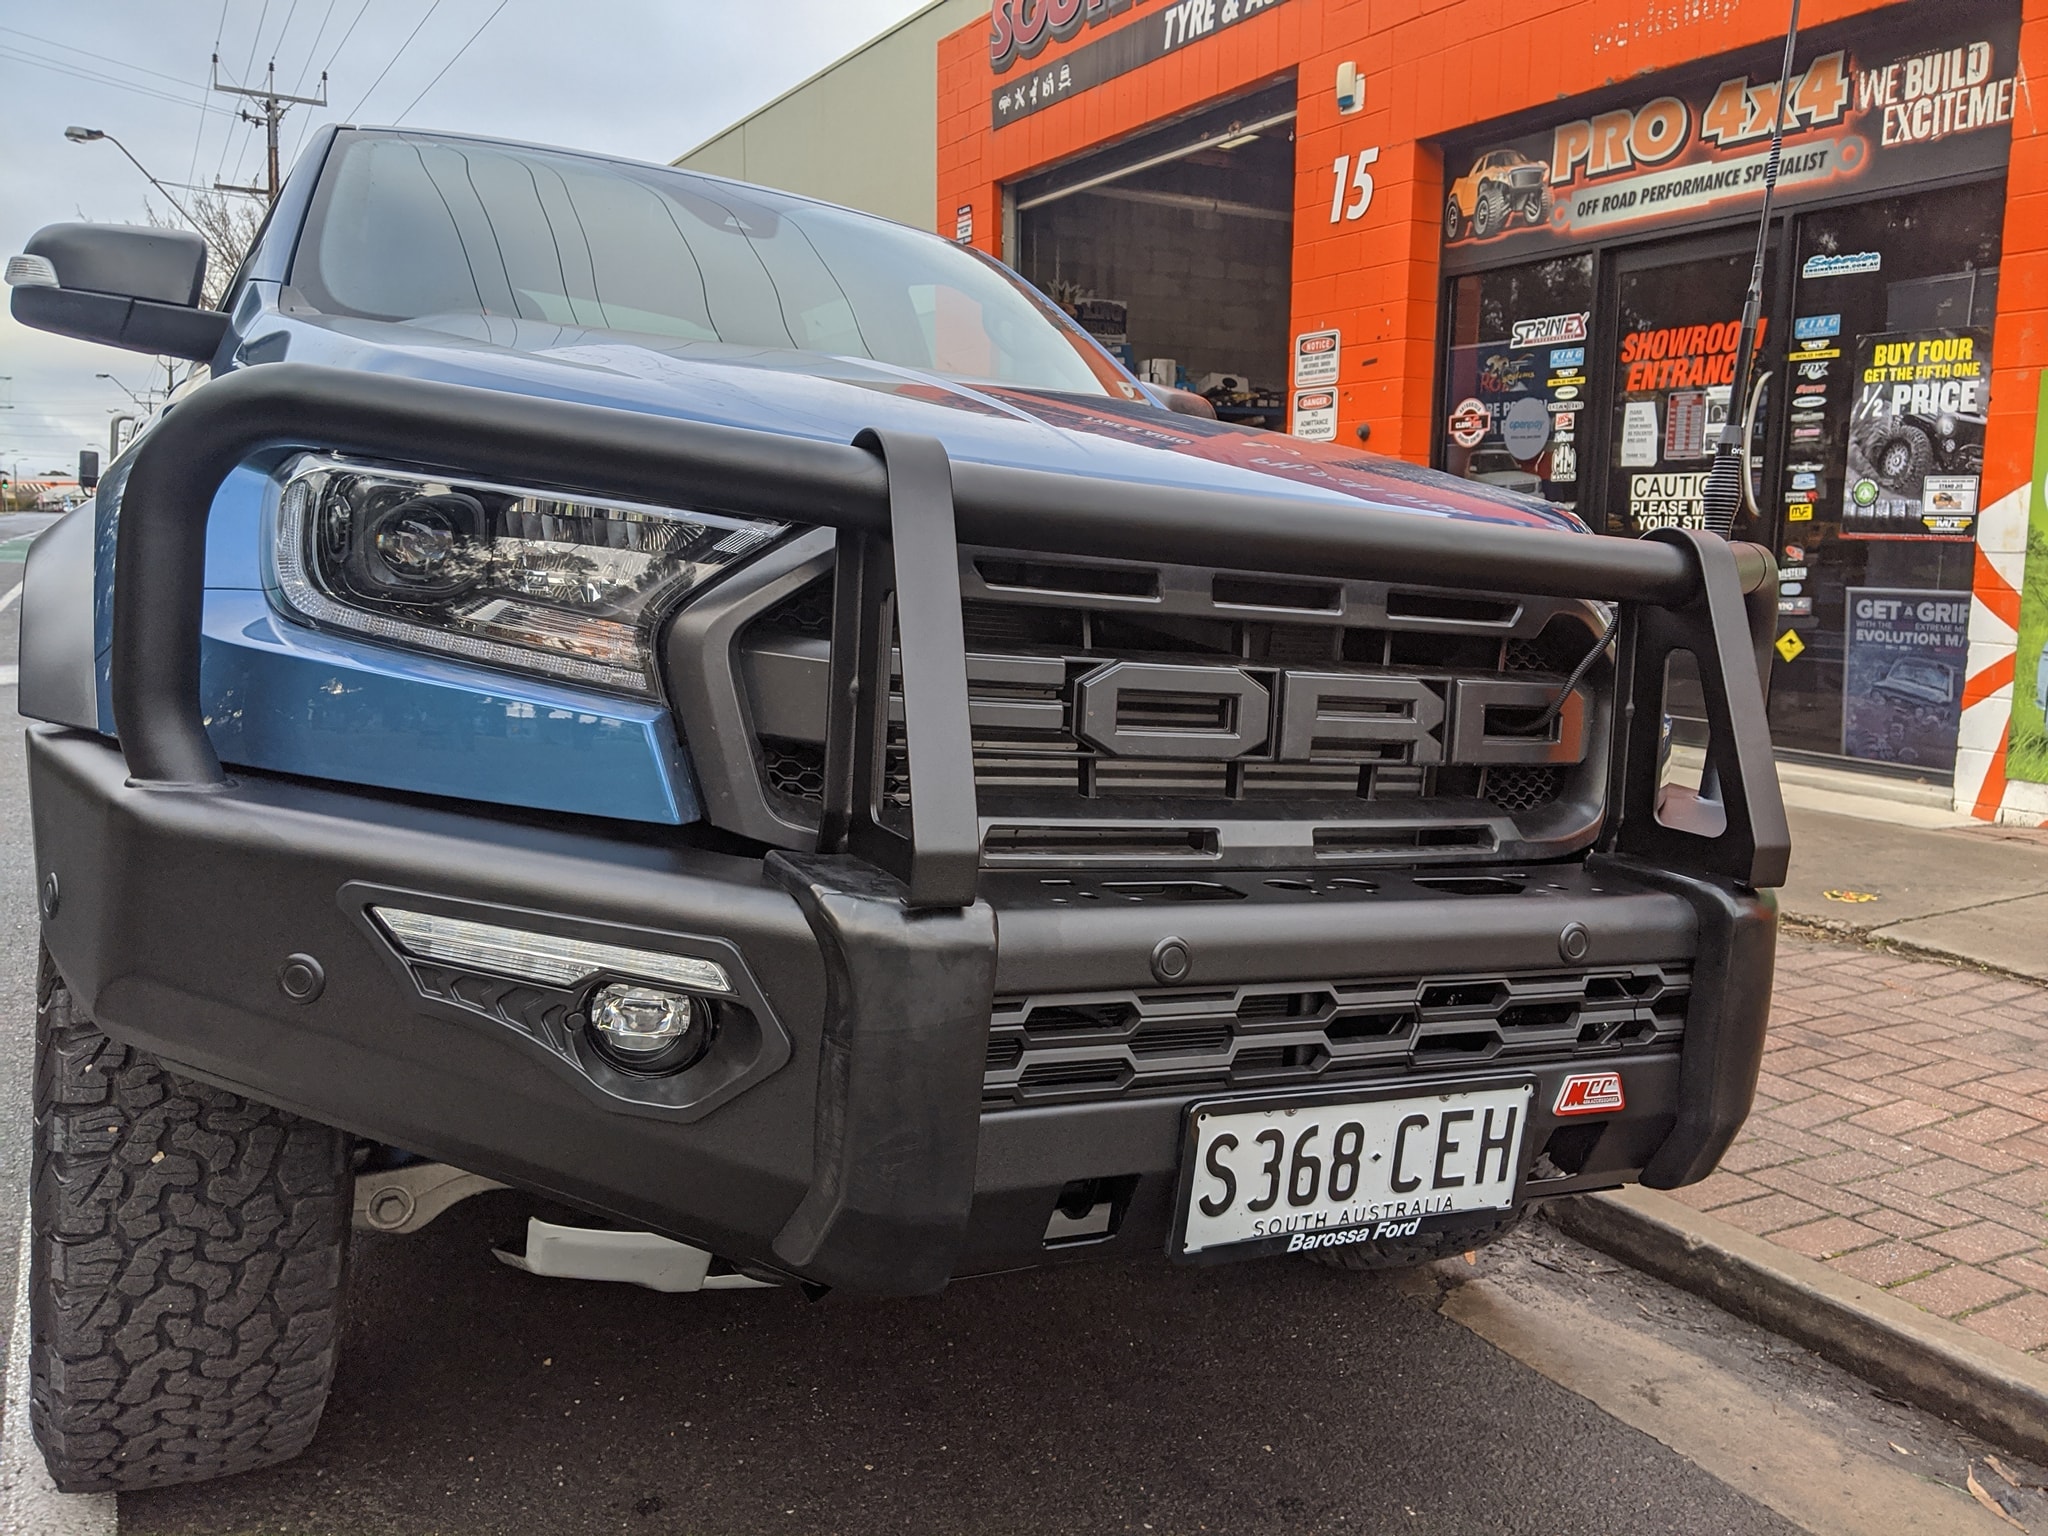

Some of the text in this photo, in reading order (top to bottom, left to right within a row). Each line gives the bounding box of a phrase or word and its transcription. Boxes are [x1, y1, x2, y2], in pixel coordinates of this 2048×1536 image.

[1164, 0, 1239, 50] TYRE &
[1859, 41, 1990, 110] WE BUILD
[1551, 97, 1687, 184] PRO
[1330, 146, 1379, 223] 15
[1577, 150, 1828, 217] OFF ROAD PERFORMANCE SPEIALIST
[1799, 318, 1837, 329] KING
[1306, 340, 1330, 351] NOTICE
[1552, 350, 1582, 360] KING
[1874, 338, 1974, 367] BUY FOUR
[1626, 351, 1757, 392] ENTRANC
[1864, 362, 1980, 383] GET THE FIFTH ONE
[1303, 397, 1327, 407] DANGER
[1892, 380, 1980, 416] PRICE
[1300, 418, 1328, 427] ADMITTANCE
[1305, 427, 1331, 435] WORKSHOP
[1634, 475, 1711, 498] CAUTI
[1631, 500, 1688, 516] PLEASE
[1638, 515, 1706, 531] YOUR ST
[1778, 567, 1807, 578] ILSTEIN
[1856, 599, 1901, 620] GET
[1904, 606, 1914, 617] A
[1856, 620, 1876, 629] WITH
[1877, 621, 1893, 629] THE
[1915, 623, 1952, 632] EXTREME
[1856, 629, 1964, 647] EVOLUTION M/
[1253, 1196, 1454, 1238] SOUTH AUSTRALIA
[1287, 1217, 1422, 1253] Barossa Ford
